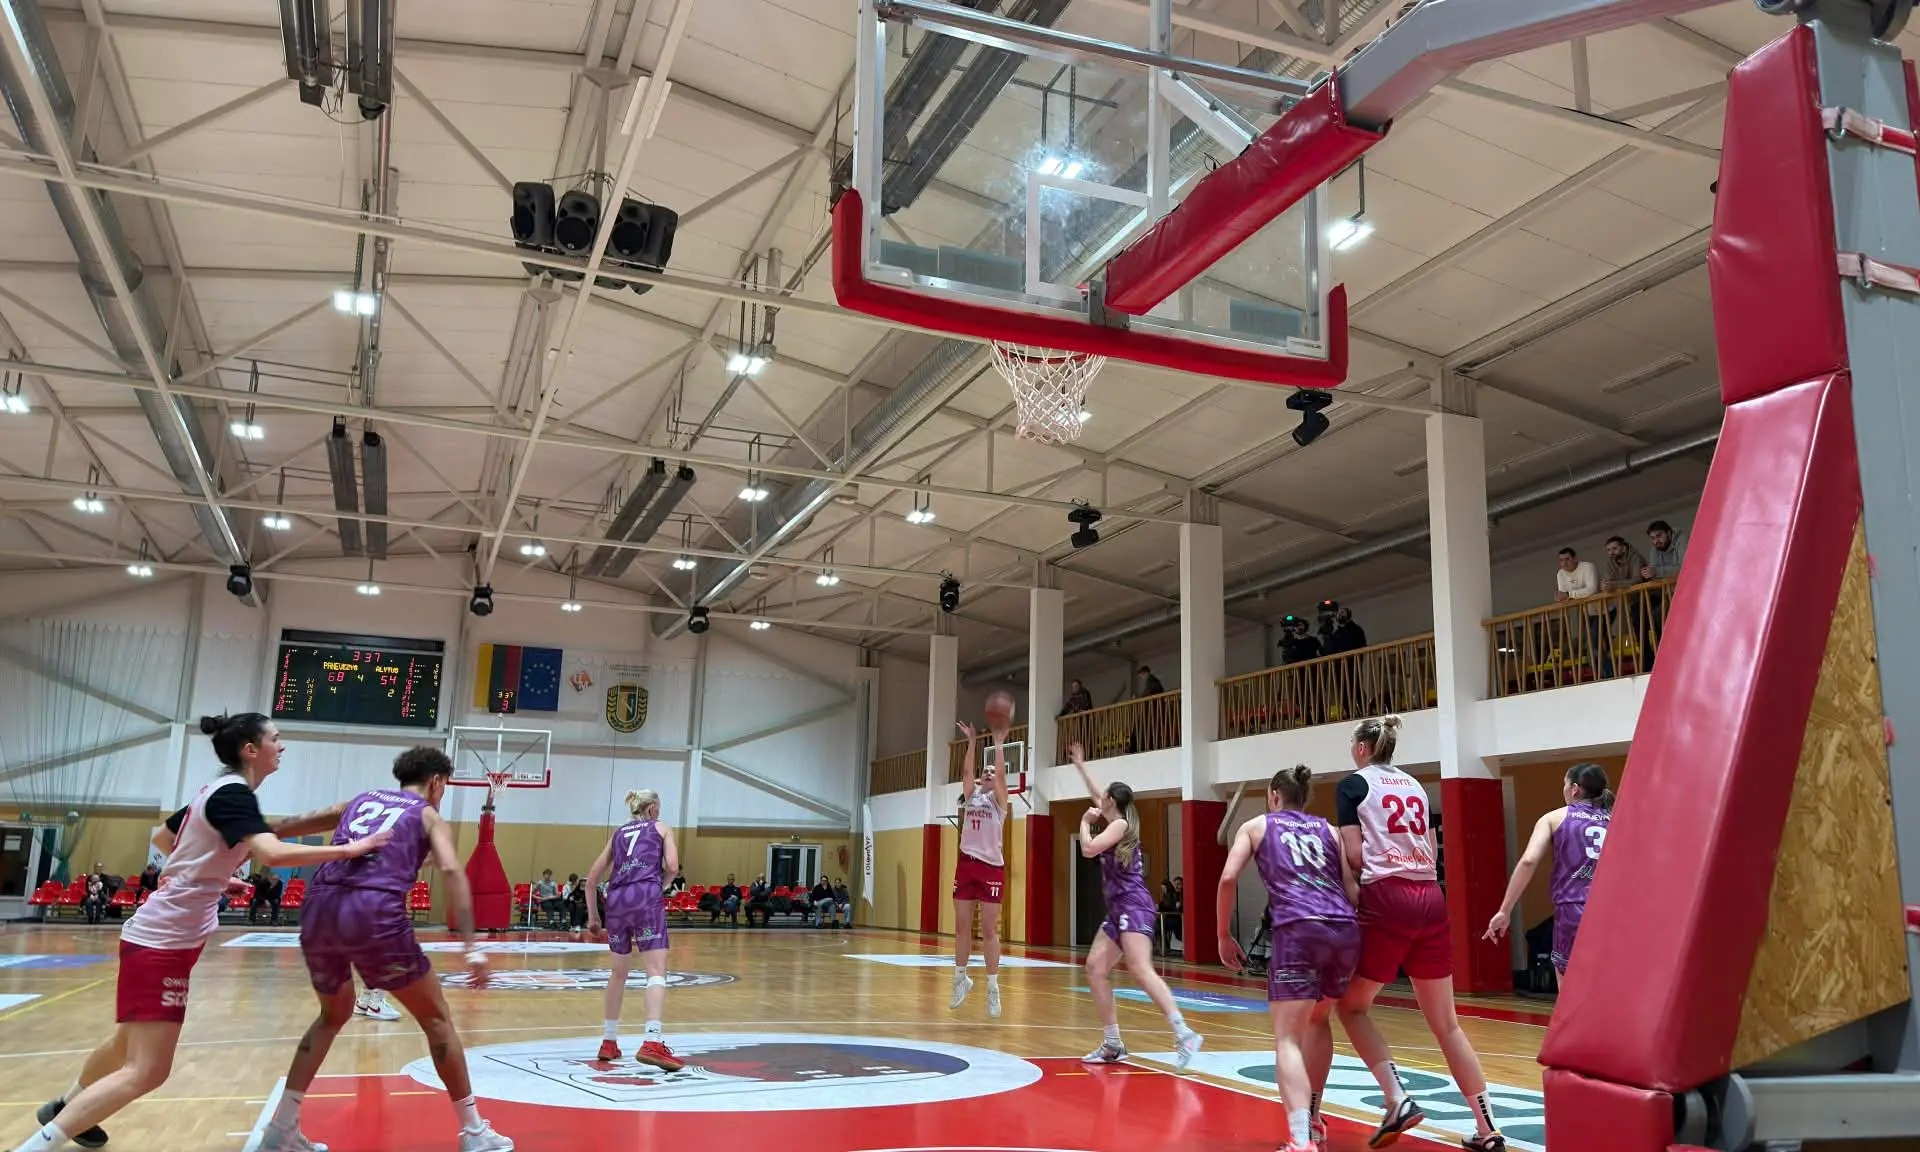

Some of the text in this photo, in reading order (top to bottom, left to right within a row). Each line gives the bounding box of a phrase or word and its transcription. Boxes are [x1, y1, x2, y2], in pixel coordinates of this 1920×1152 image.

[327, 671, 345, 682] 68
[357, 673, 364, 682] 4
[380, 675, 397, 685] 54
[330, 686, 337, 695] 4
[387, 688, 395, 698] 2
[348, 801, 406, 835] 21
[1381, 794, 1427, 836] 23
[972, 819, 981, 831] 11
[623, 829, 641, 857] 7
[1584, 825, 1608, 860] 3
[1279, 830, 1328, 870] 10
[989, 886, 1000, 897] 11
